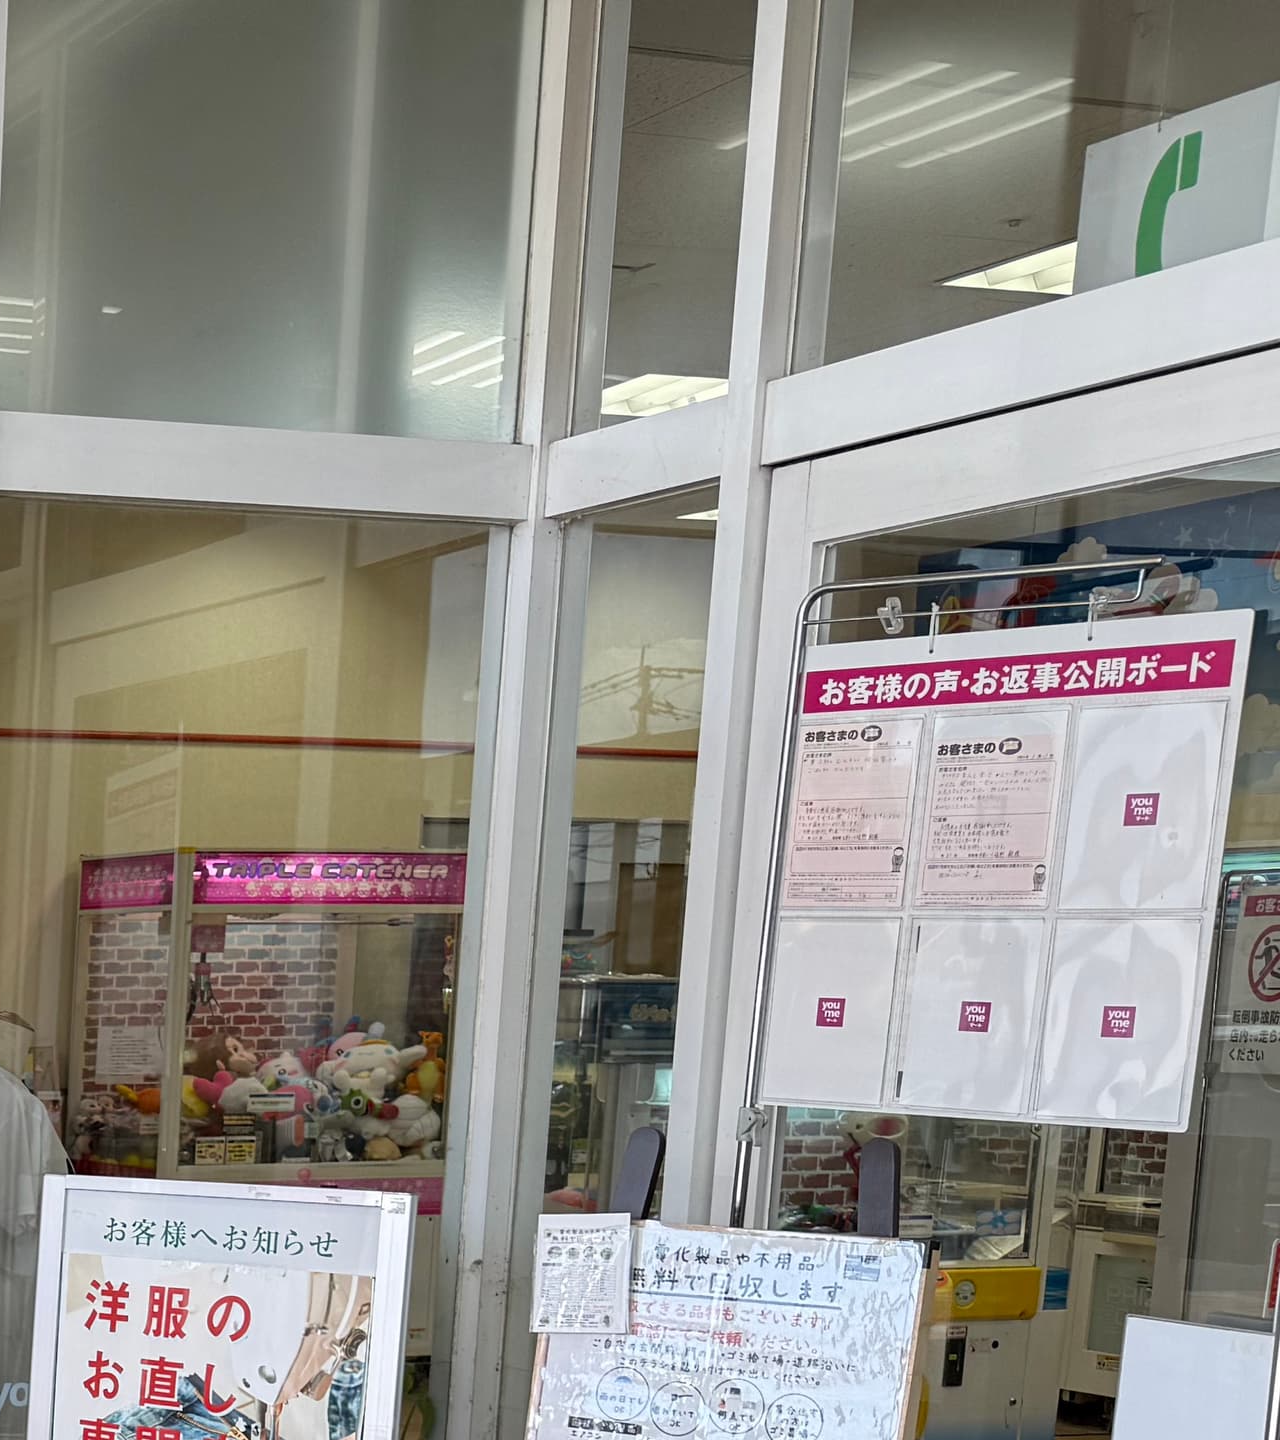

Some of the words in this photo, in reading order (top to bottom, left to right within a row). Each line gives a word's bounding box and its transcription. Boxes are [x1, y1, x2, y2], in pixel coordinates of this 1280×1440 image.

[818, 650, 1217, 707] お客様の声・お返事公開ボード
[1130, 797, 1153, 809] you
[1133, 806, 1153, 815] me
[214, 862, 313, 879] TRIPLE
[321, 863, 449, 880] CATCHER
[821, 1000, 841, 1011] you
[964, 1004, 986, 1016] you
[824, 1008, 841, 1018] me
[967, 1013, 986, 1023] me
[1107, 1008, 1130, 1020] you
[1111, 1018, 1130, 1028] me
[1228, 1048, 1265, 1062] ください
[103, 1215, 339, 1260] お客様へお知らせ
[83, 1279, 252, 1342] 洋服の
[82, 1350, 237, 1418] お直し
